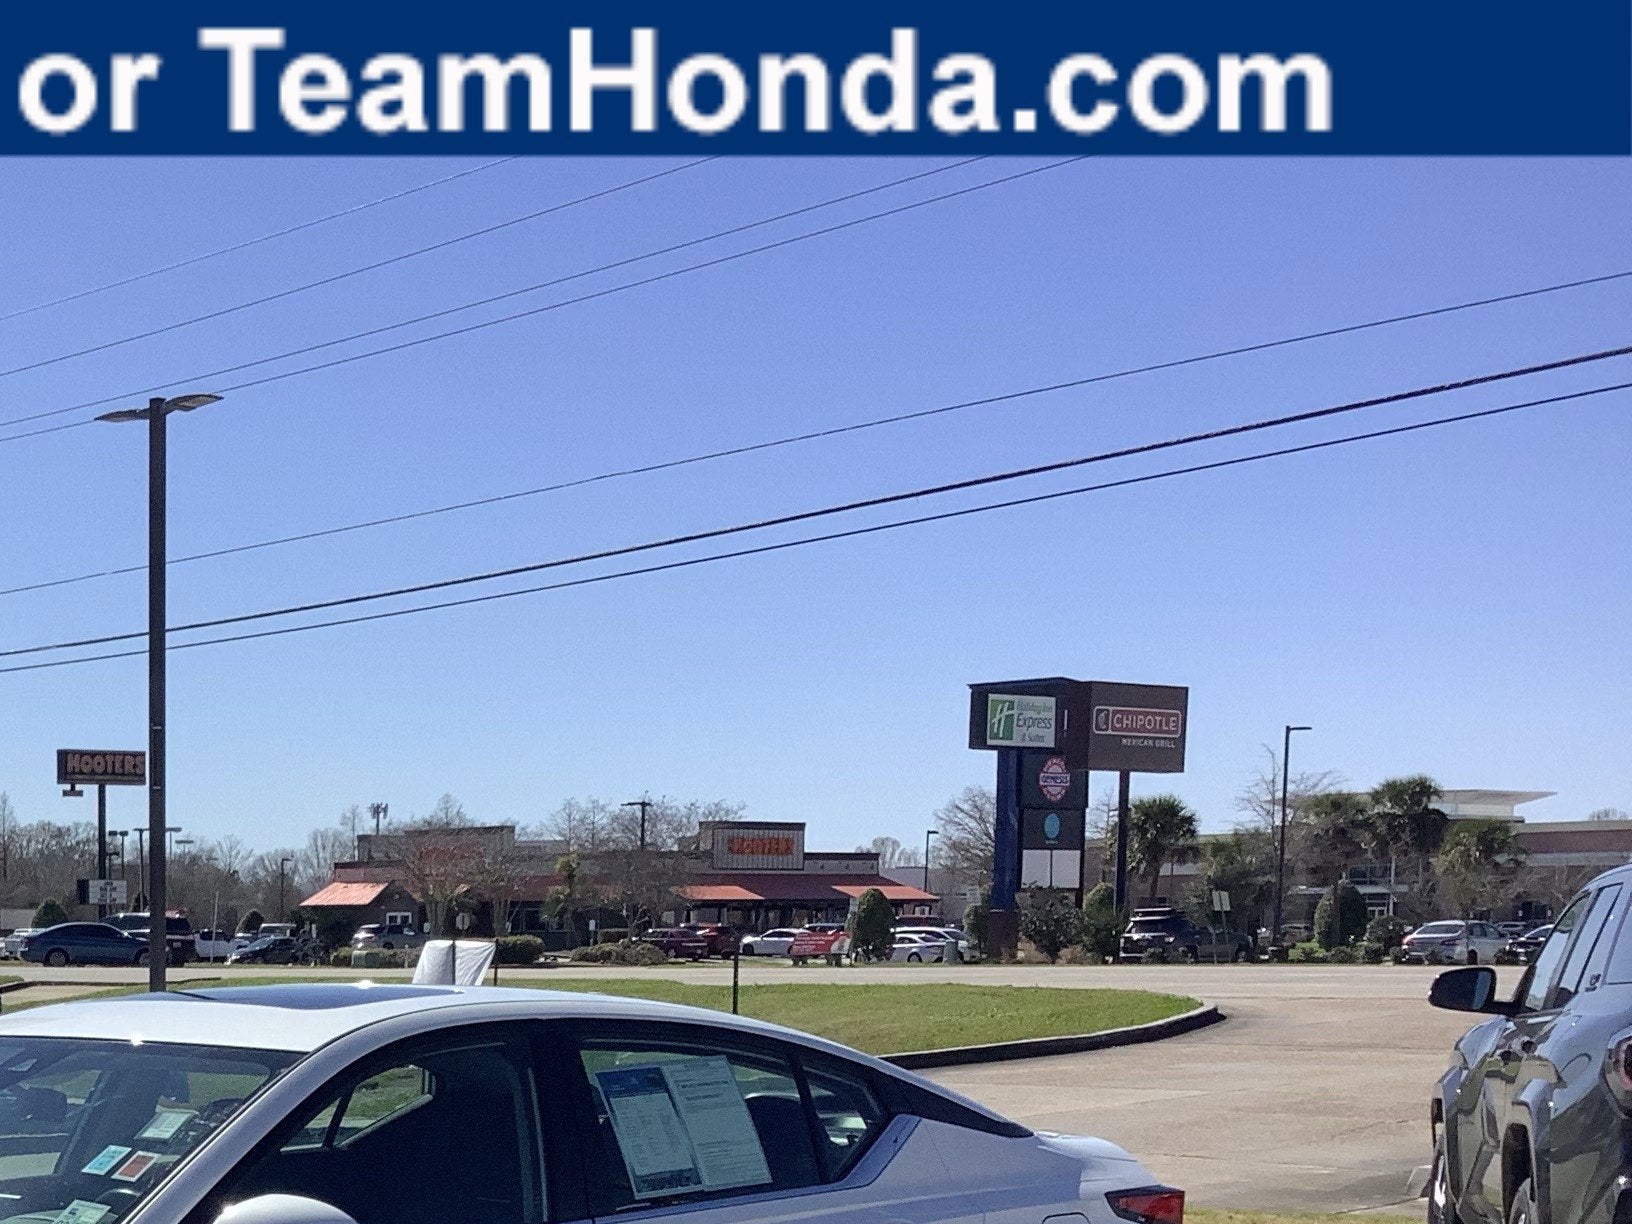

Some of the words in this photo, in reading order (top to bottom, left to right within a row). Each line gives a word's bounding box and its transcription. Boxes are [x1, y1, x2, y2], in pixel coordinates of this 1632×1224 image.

[1016, 712, 1052, 731] Express
[1113, 713, 1177, 731] CHIPOTLE
[1122, 738, 1153, 747] MEXICAN
[1155, 739, 1176, 748] GRILL
[66, 753, 145, 775] HOOTERS
